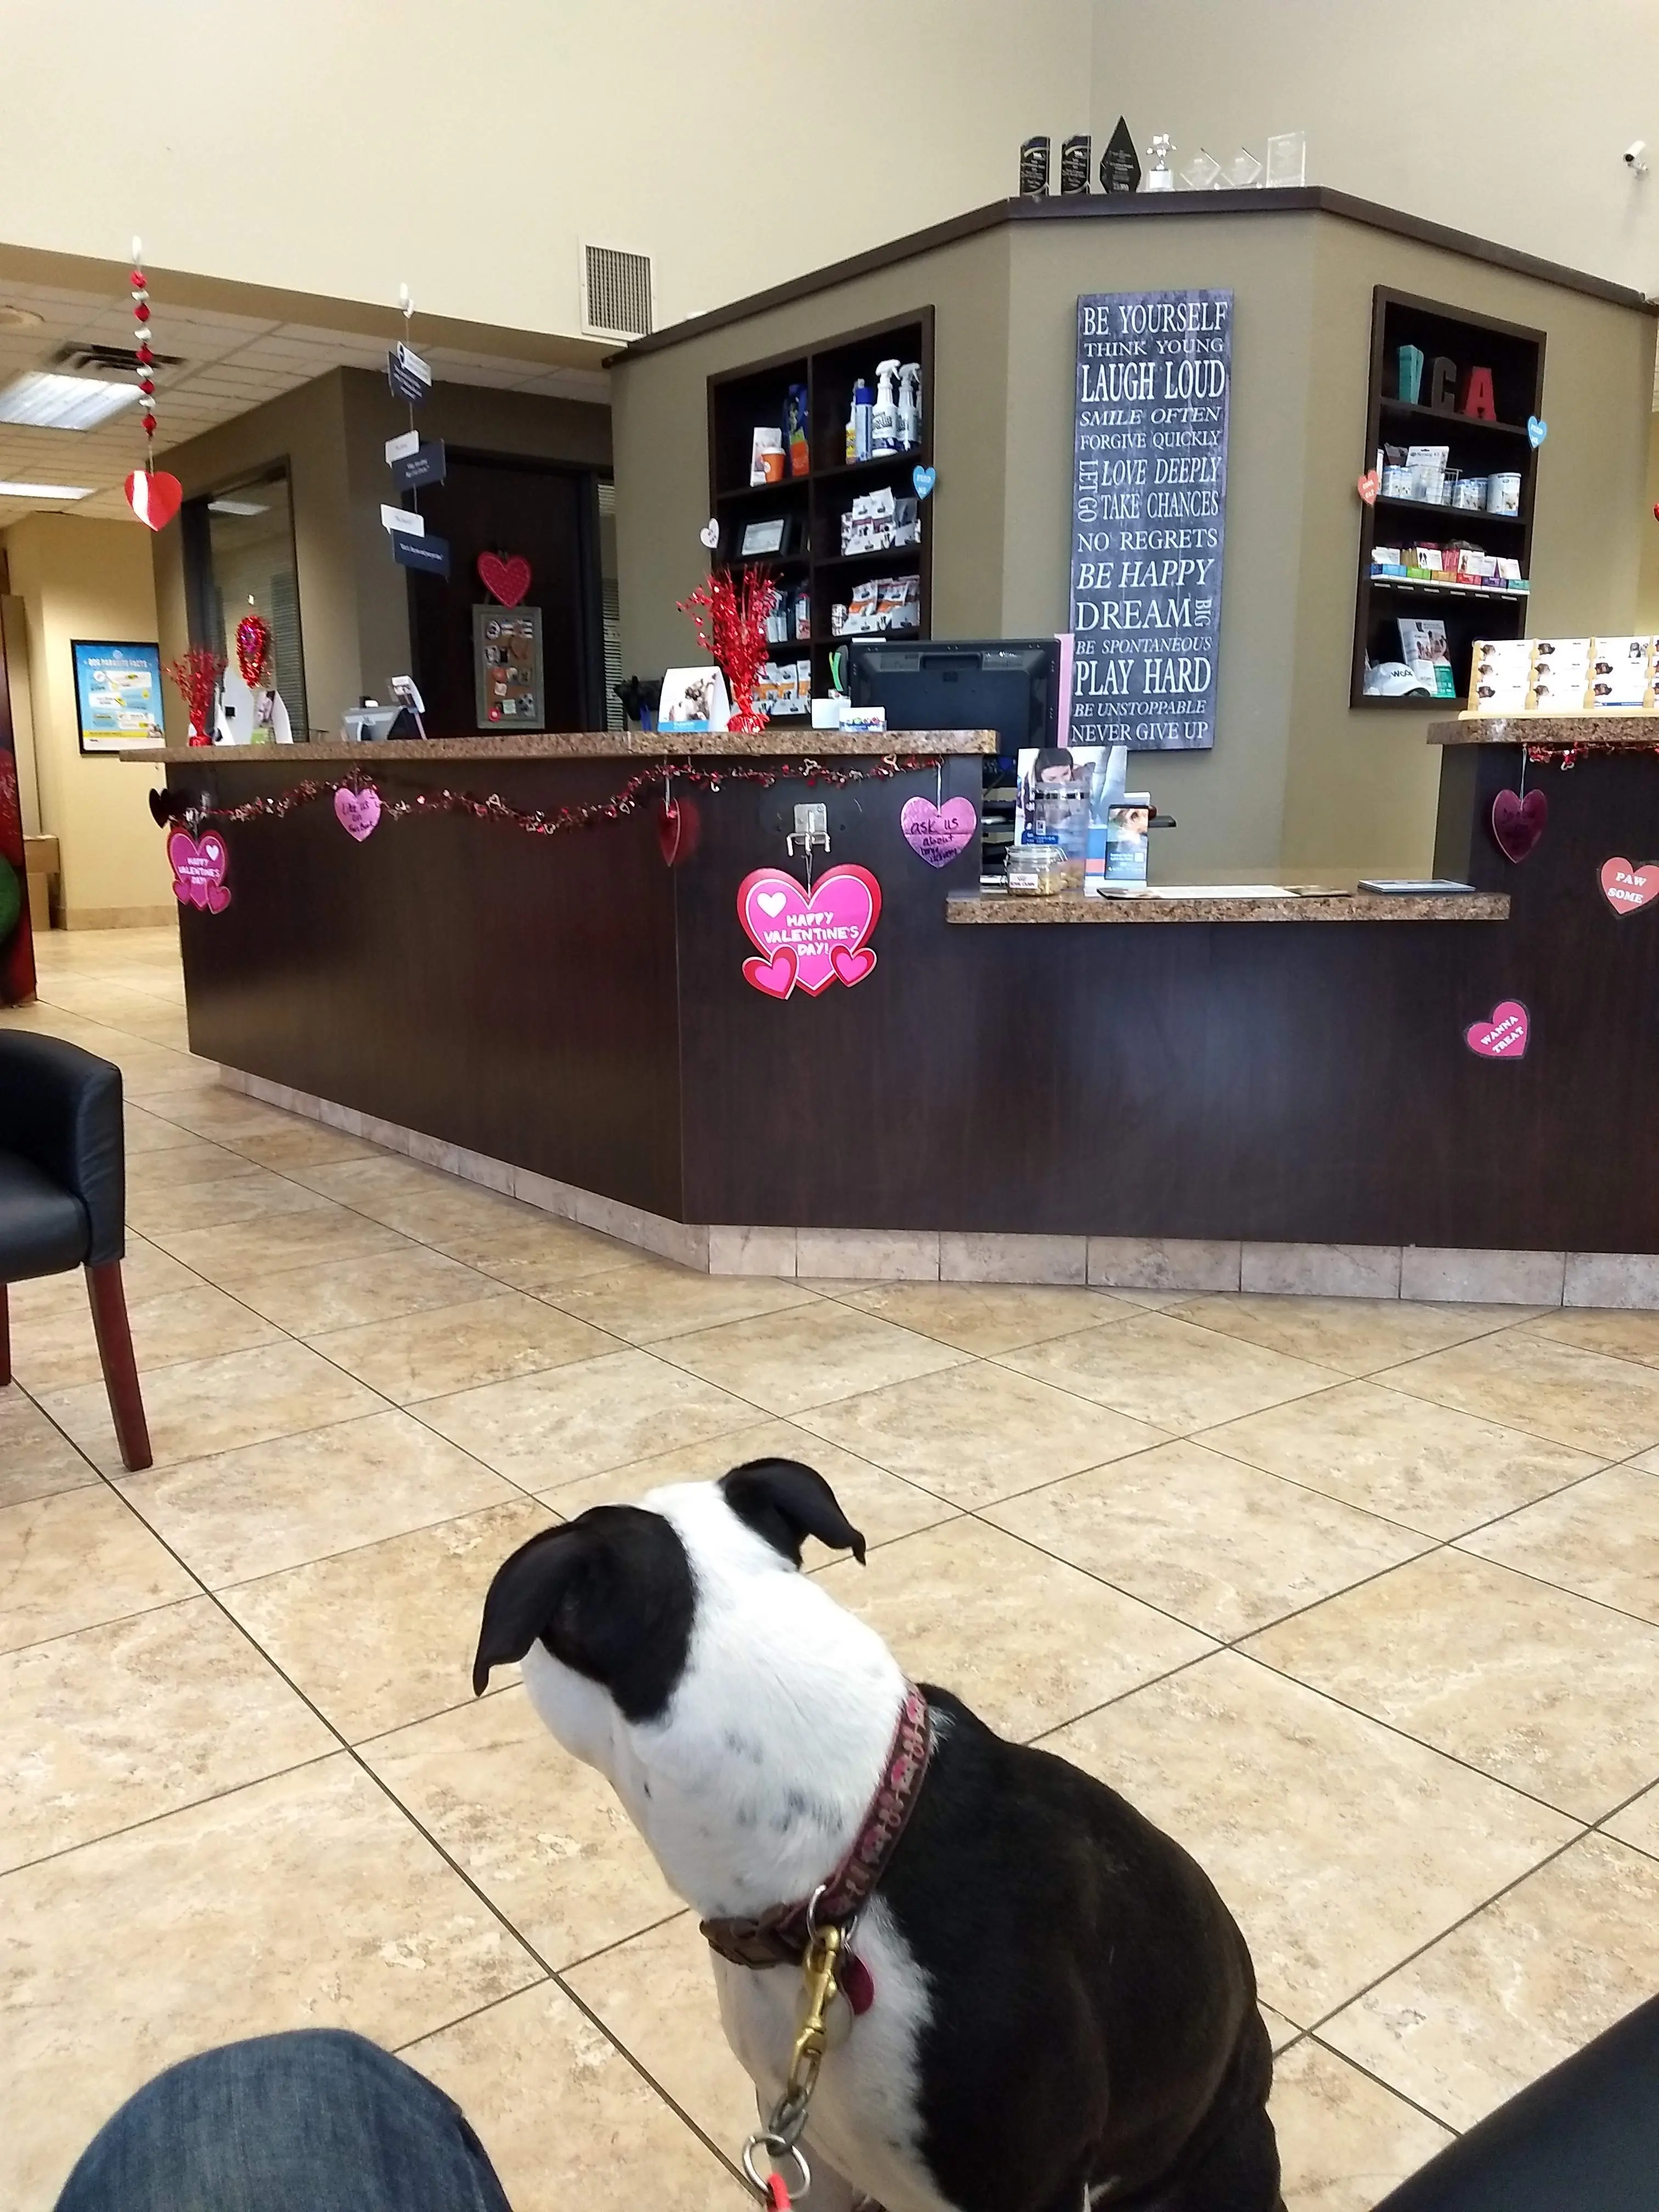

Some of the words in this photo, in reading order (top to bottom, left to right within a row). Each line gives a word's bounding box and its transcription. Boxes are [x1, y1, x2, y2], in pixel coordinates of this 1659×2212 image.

[1083, 306, 1109, 335] BE
[1119, 302, 1228, 334] YOURSELF
[1084, 340, 1147, 357] THINK
[1156, 338, 1223, 355] YOUNG
[1081, 362, 1156, 402] LAUGH
[1164, 360, 1226, 399] LOUD
[1080, 409, 1142, 426] SMILE
[1151, 407, 1222, 424] OFTEN
[1080, 433, 1147, 450] FORGIVE
[1153, 431, 1221, 450] QUICKLY
[1079, 459, 1098, 493] LET
[1101, 459, 1148, 486] LOVE
[1154, 457, 1222, 484] DEEPLY
[1078, 496, 1097, 522] GO
[1101, 493, 1141, 520] TAKE
[1147, 490, 1219, 520] CHANCES
[1077, 532, 1110, 552] NO
[1120, 528, 1218, 550] REGRETS
[1076, 562, 1114, 589] BE
[1118, 558, 1215, 588] HAPPY
[1075, 598, 1192, 631] DREAM
[1194, 599, 1213, 628] BIG
[1076, 640, 1096, 654] BE
[1101, 636, 1212, 654] SPONTANEOUS
[1074, 659, 1135, 696] PLAY
[1143, 657, 1211, 694] HARD
[1074, 702, 1094, 717] BE
[1097, 699, 1206, 716] UNSTOPPABLE
[1071, 723, 1132, 742] NEVER
[1136, 722, 1178, 741] GIVE
[1184, 721, 1208, 739] UP
[911, 819, 939, 834] ask
[944, 818, 958, 830] us
[923, 834, 953, 846] about
[1615, 872, 1647, 887] PAW
[1607, 887, 1644, 904] SOME
[786, 911, 834, 927] HAPPY
[763, 926, 859, 944] VALENTINE'S
[797, 941, 829, 956] DAY!
[1481, 1016, 1519, 1045] WANNA
[1492, 1026, 1524, 1053] TREAT
